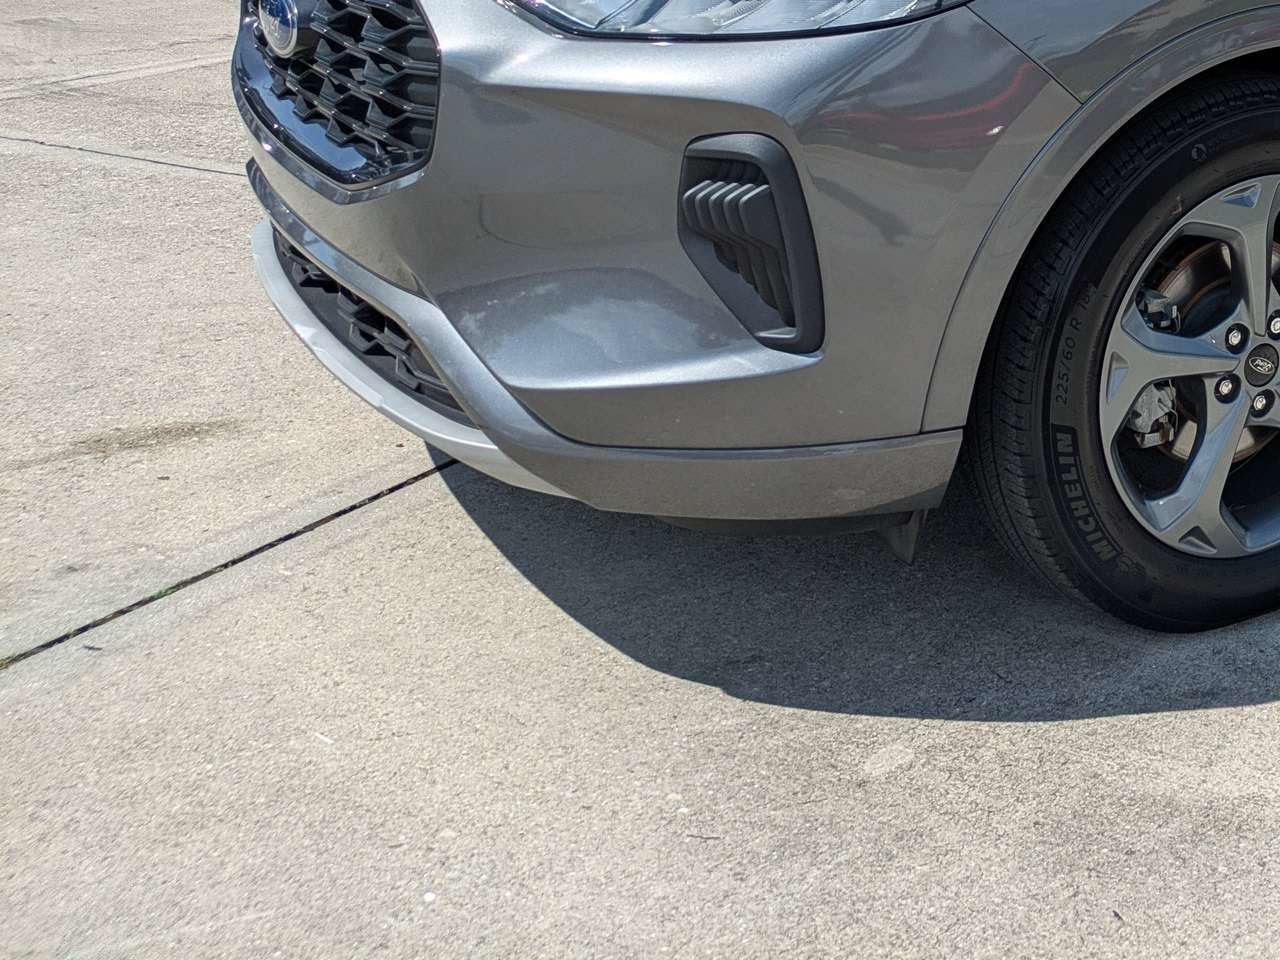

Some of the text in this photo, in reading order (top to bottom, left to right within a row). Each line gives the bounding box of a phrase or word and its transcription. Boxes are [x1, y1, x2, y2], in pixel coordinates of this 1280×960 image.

[1055, 336, 1076, 406] 225/60
[1070, 317, 1083, 332] R
[1055, 432, 1118, 562] MICHELIN
